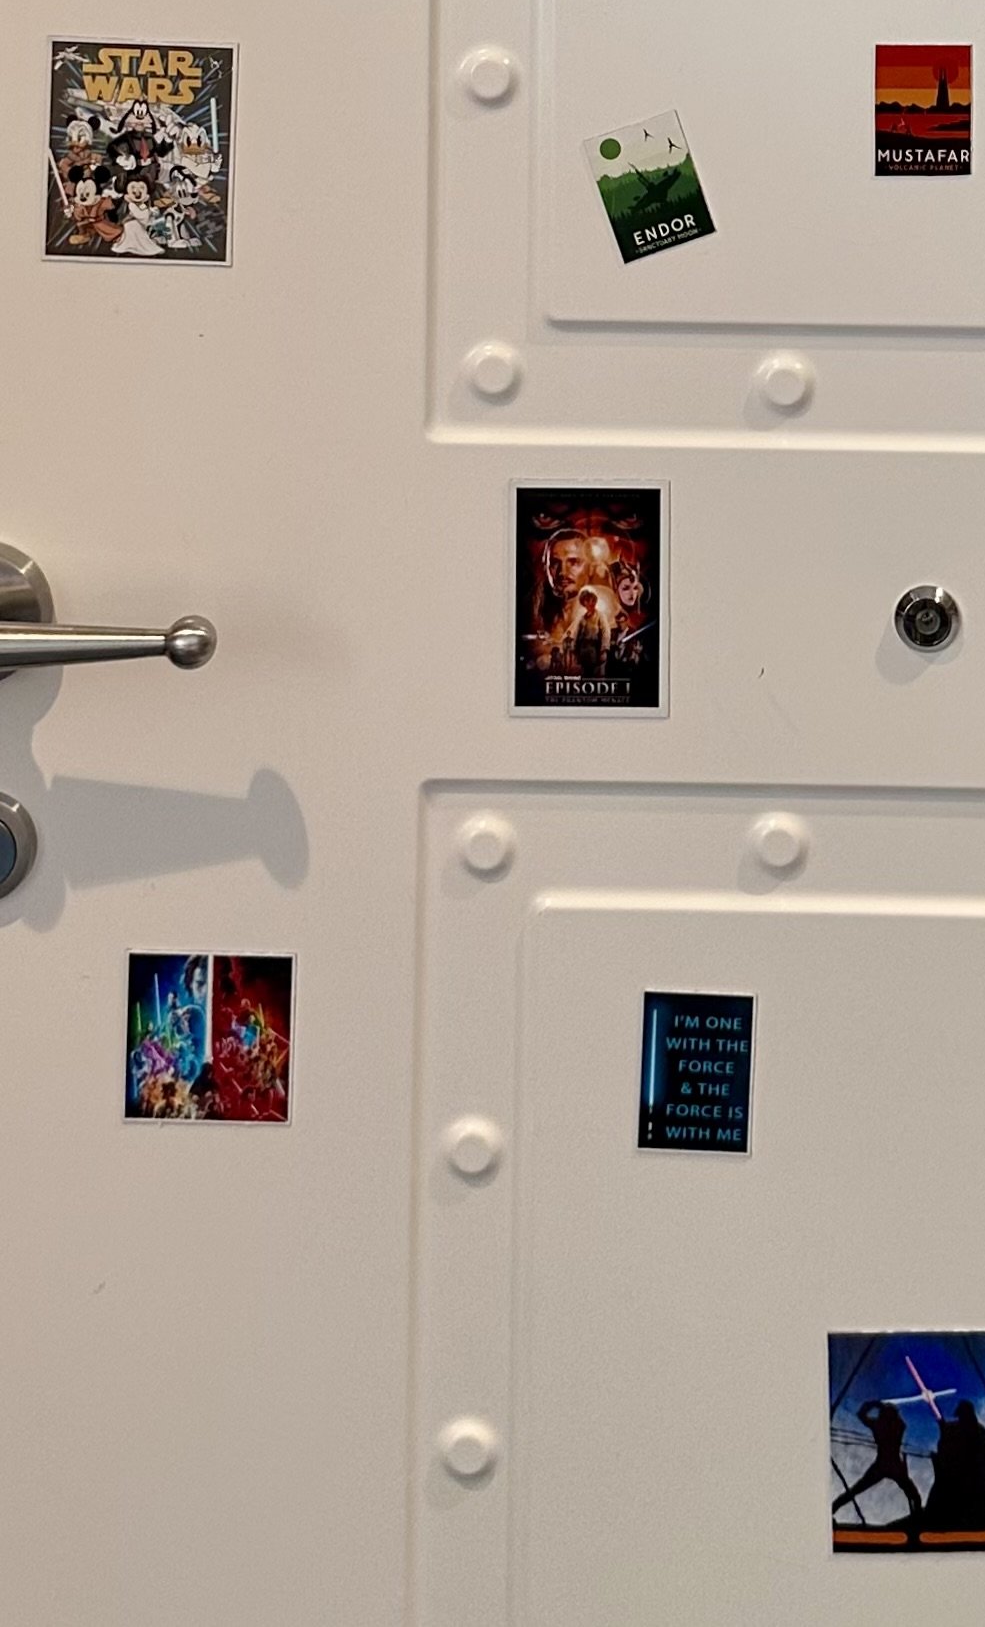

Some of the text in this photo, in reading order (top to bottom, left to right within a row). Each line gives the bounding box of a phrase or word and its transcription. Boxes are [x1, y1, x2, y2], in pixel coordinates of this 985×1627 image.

[82, 47, 203, 76] STAR
[82, 74, 203, 105] WARS
[877, 148, 970, 163] MUSTAFAR
[633, 214, 696, 246] ENDOR
[545, 681, 631, 694] EPISODE I
[674, 1015, 742, 1030] I'M ONE
[666, 1037, 748, 1052] WITH THE
[678, 1060, 735, 1074] FORCE
[680, 1082, 730, 1096] & THE
[666, 1103, 744, 1119] FORCE IS
[666, 1125, 742, 1141] WITH ME
